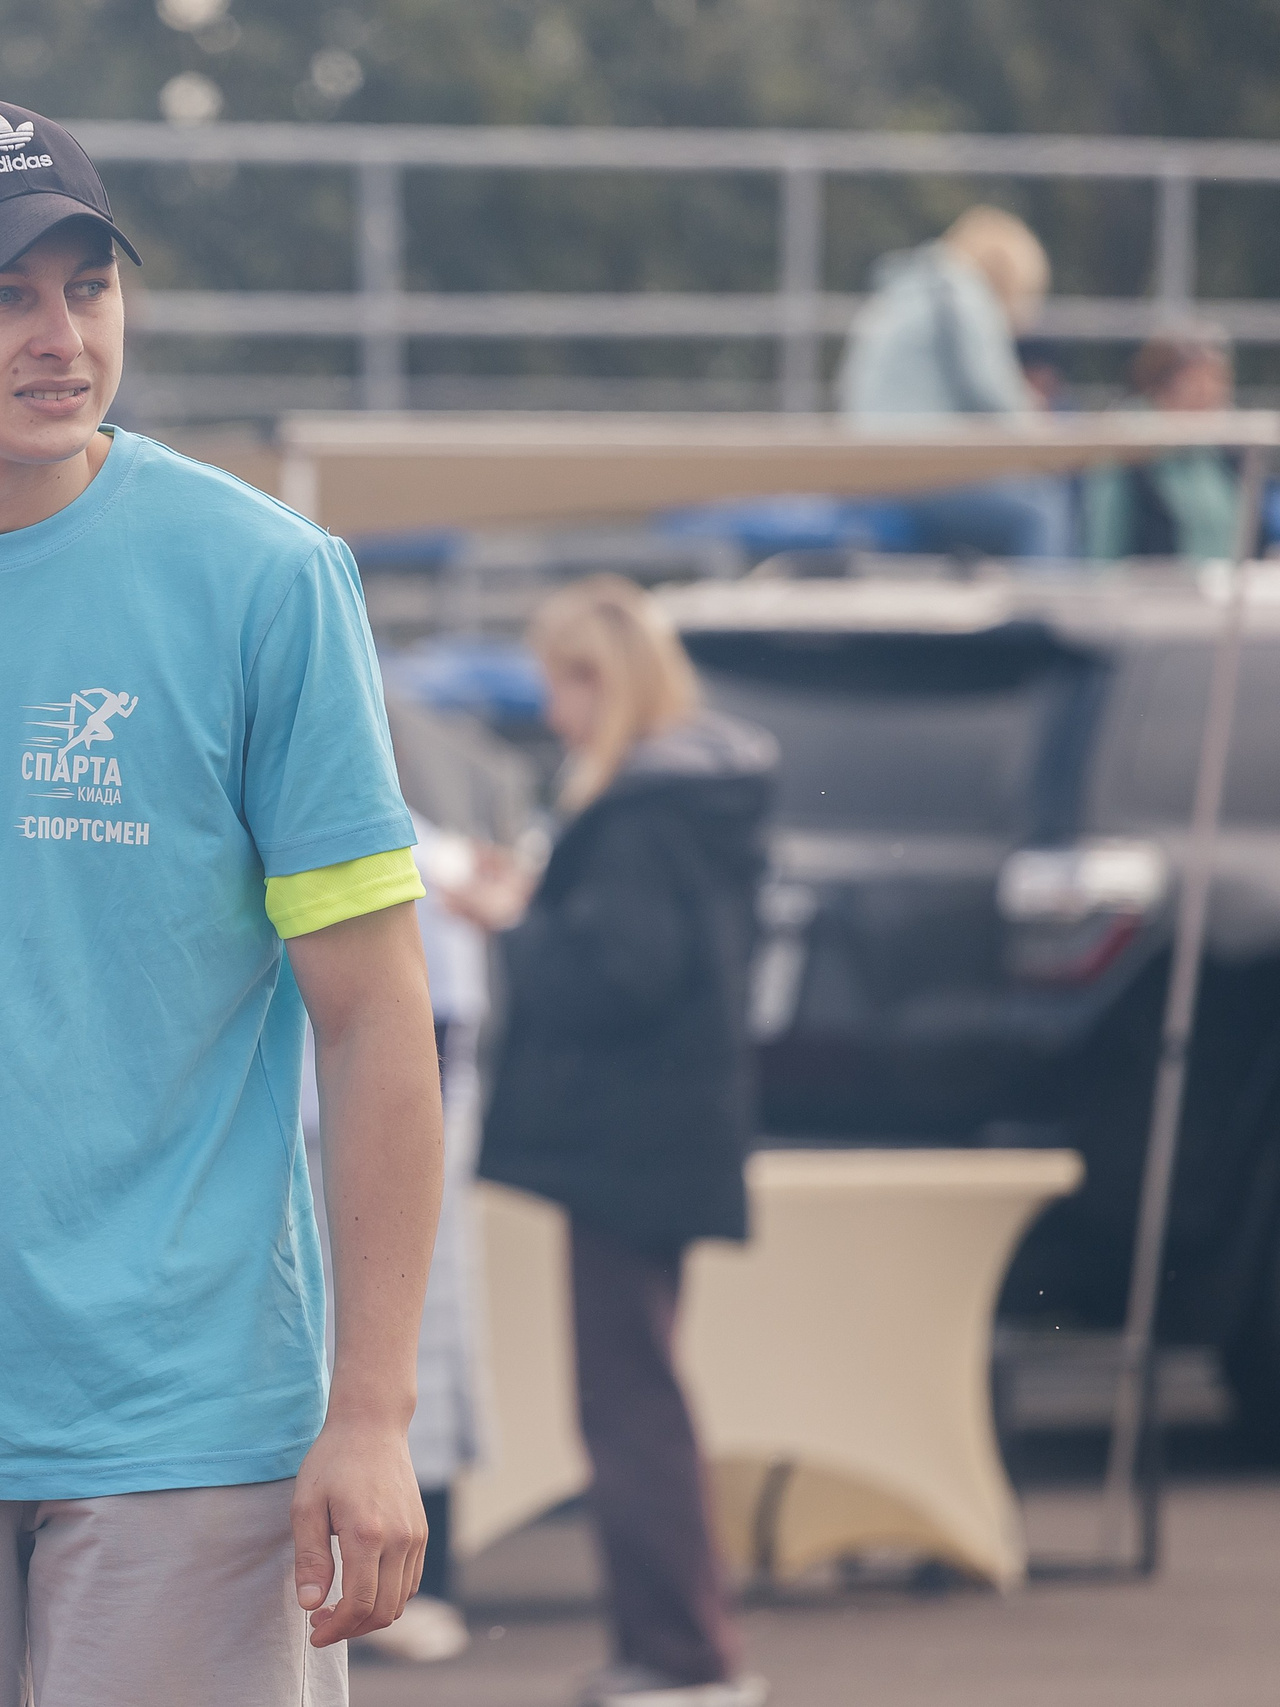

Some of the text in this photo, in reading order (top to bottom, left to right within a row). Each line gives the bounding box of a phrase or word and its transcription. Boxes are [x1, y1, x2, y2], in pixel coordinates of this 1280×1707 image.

[21, 751, 122, 786] СПАРТА
[77, 786, 122, 806] КИАДА
[23, 815, 150, 845] СПОРТСМЕН
